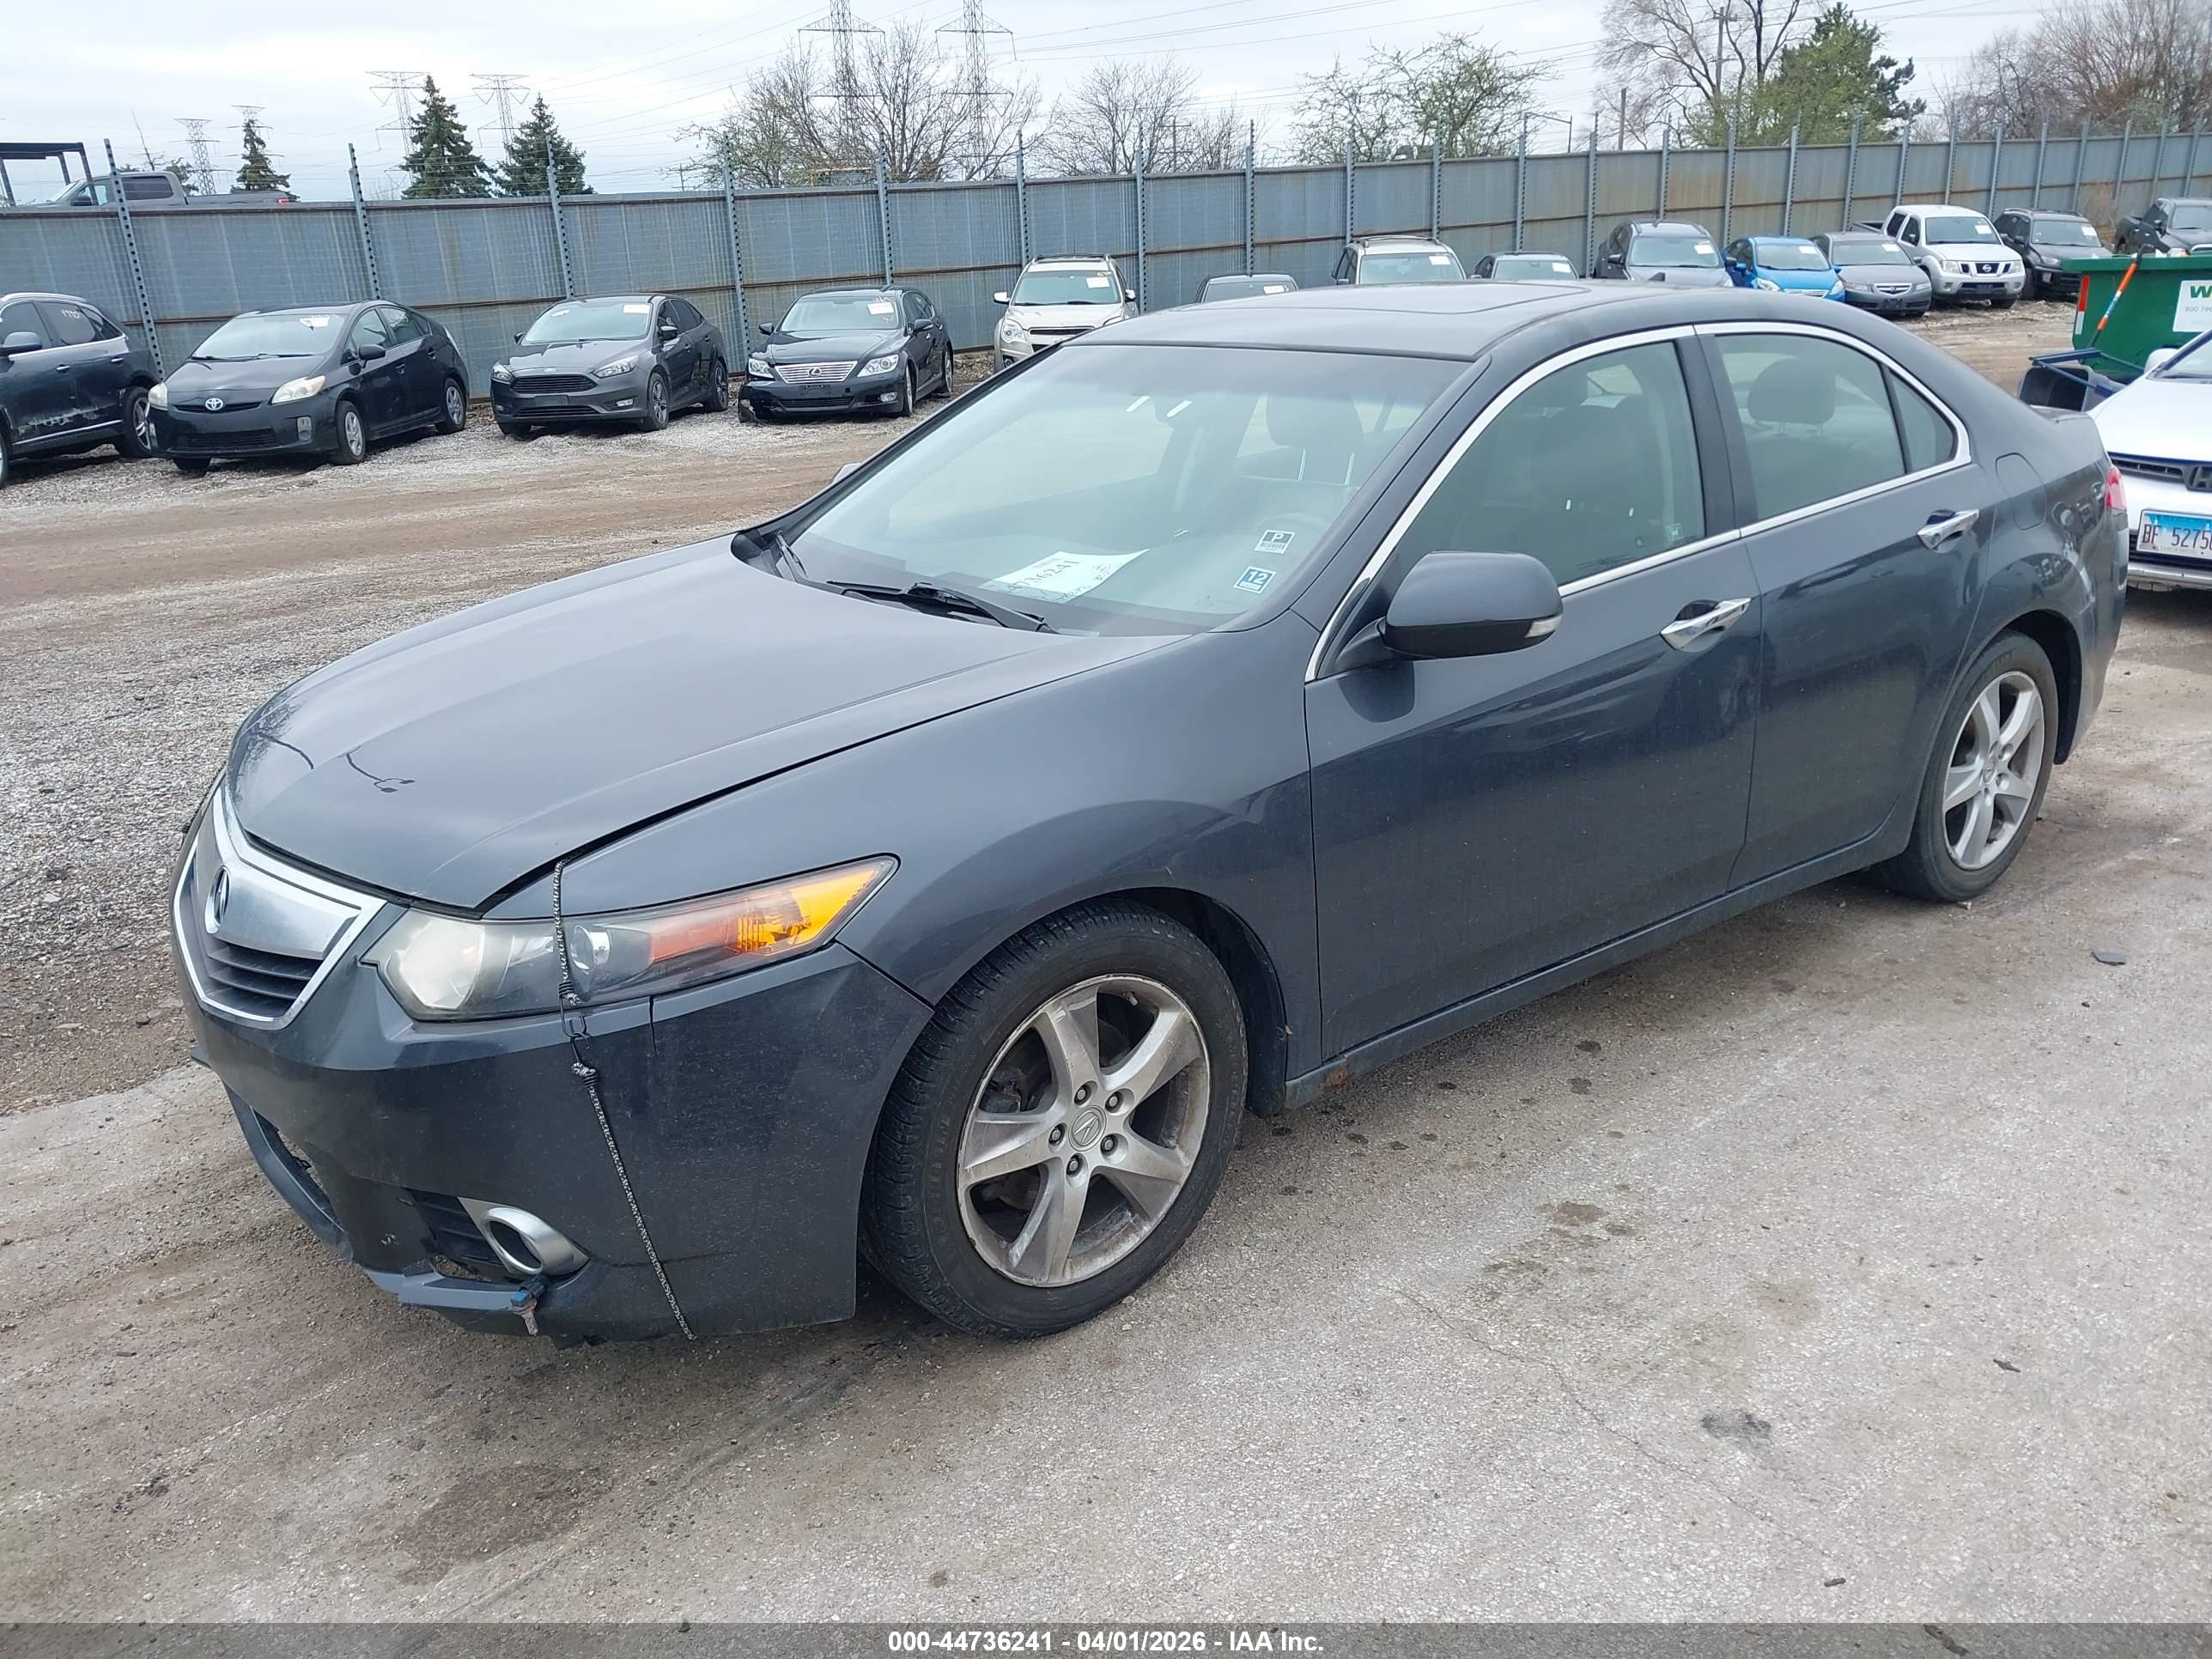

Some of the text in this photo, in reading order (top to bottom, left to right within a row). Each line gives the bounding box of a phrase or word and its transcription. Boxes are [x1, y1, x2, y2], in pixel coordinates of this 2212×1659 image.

[1271, 532, 1285, 543] P
[2142, 523, 2162, 544] BF
[1247, 570, 1268, 585] 12
